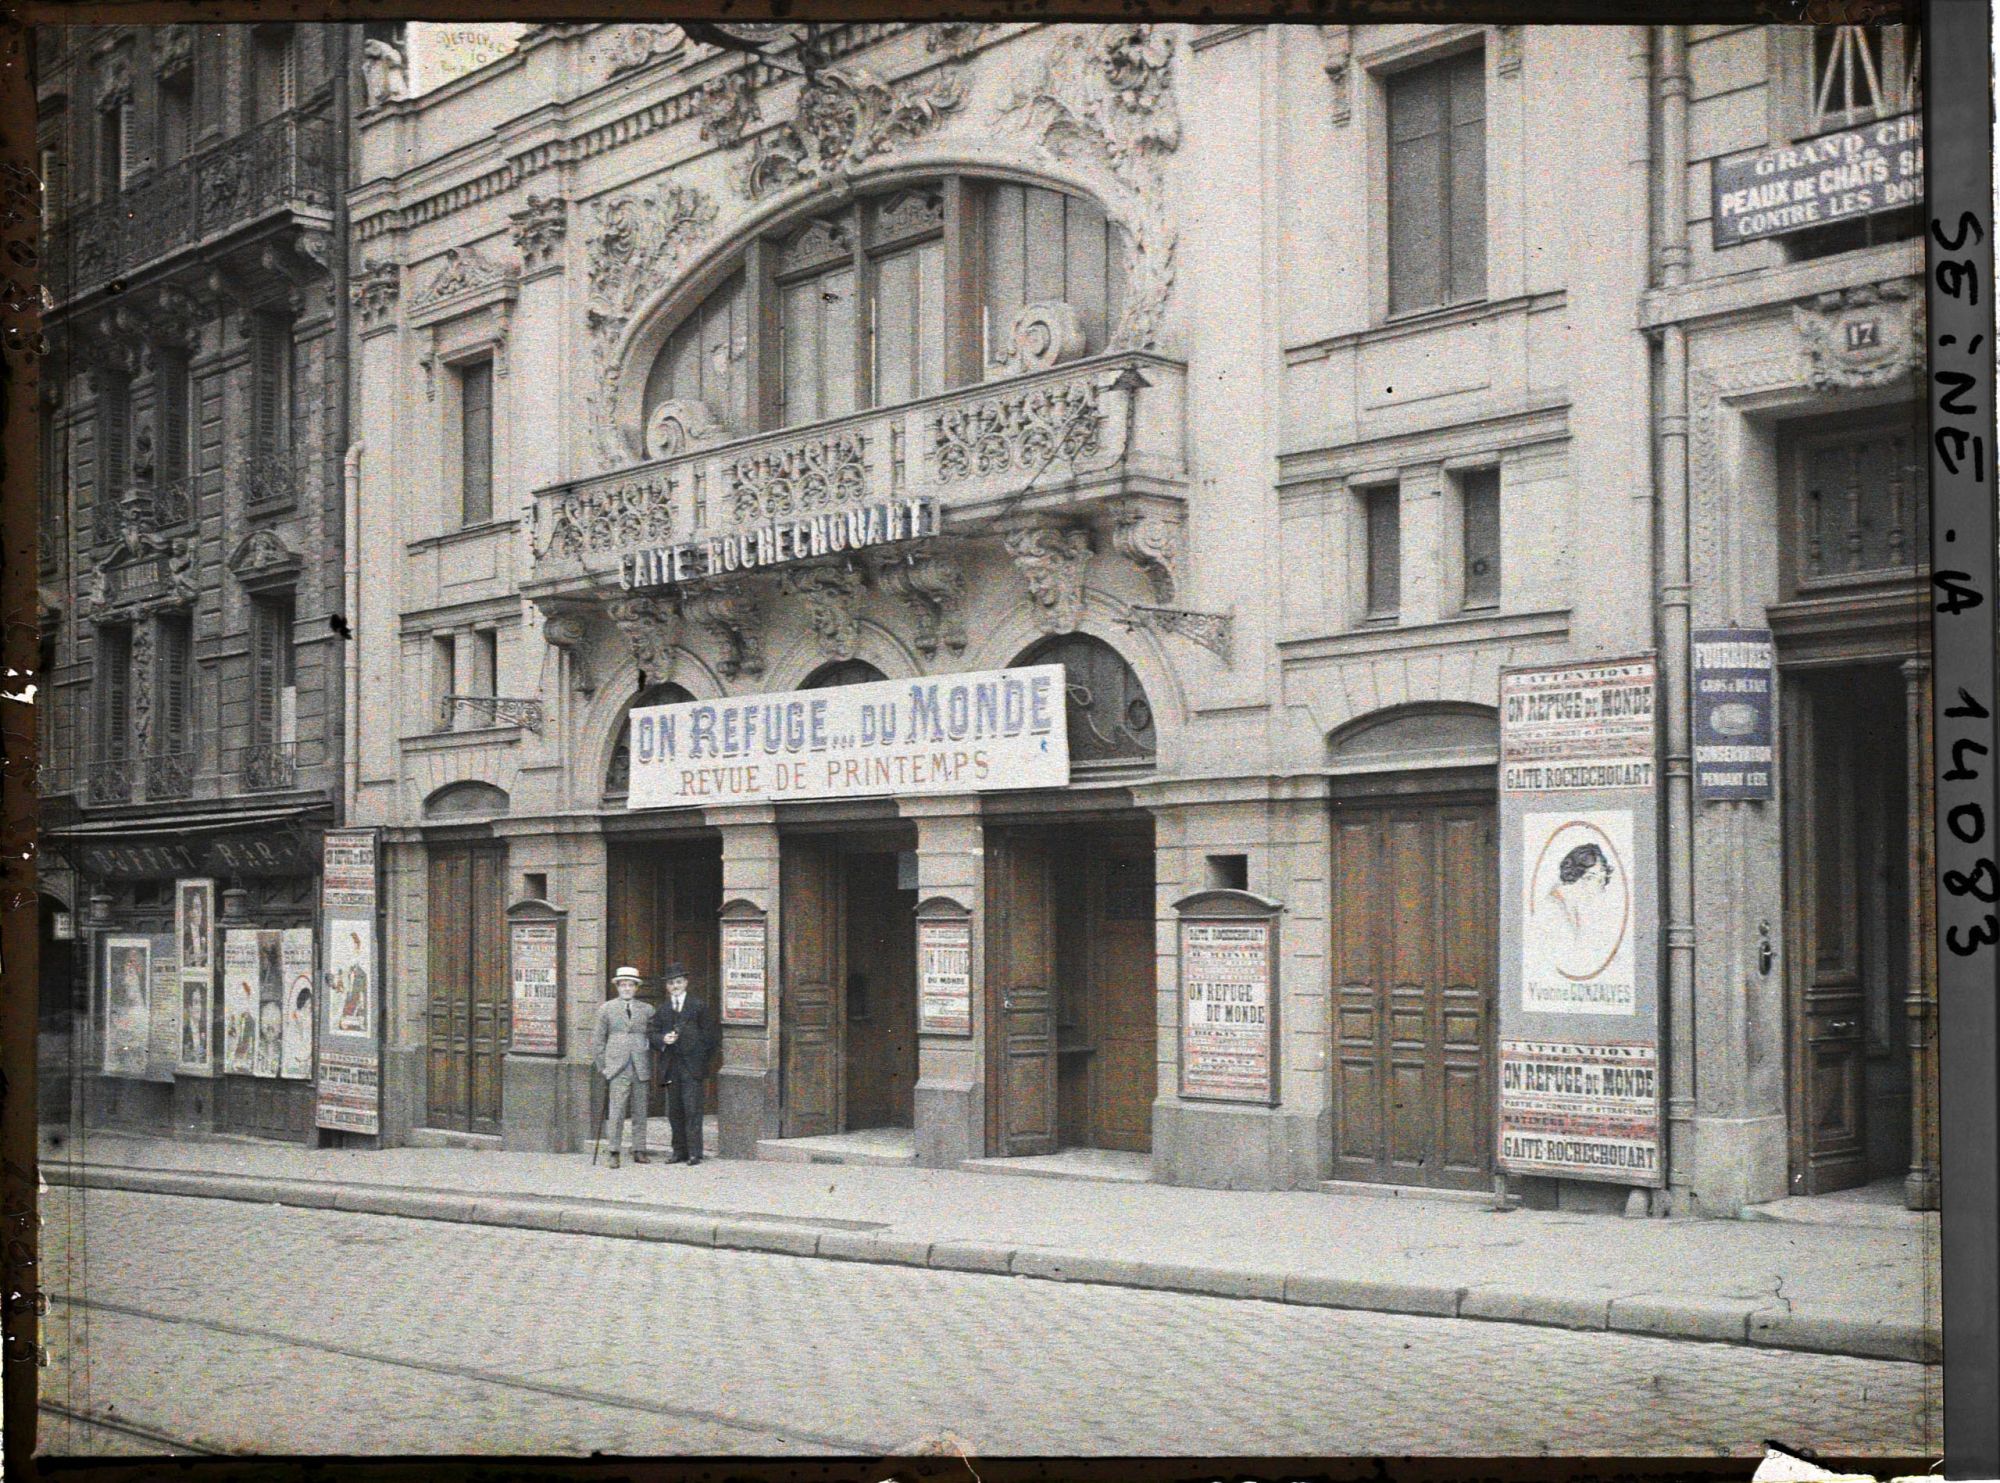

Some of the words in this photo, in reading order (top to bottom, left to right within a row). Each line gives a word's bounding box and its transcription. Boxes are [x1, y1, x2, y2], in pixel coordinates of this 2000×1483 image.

[1755, 133, 1864, 176] GRAND
[1720, 180, 1791, 217] PEAUX
[1793, 176, 1818, 201] DE
[1819, 156, 1889, 194] CHATS
[1737, 200, 1821, 236] CONTRE
[1829, 189, 1873, 216] LES
[1849, 323, 1875, 347] 17
[707, 498, 938, 575] ROCHECHOUART
[1530, 668, 1630, 682] ATTENTION
[637, 713, 677, 765] ON
[861, 702, 898, 744] DU
[909, 674, 1052, 745] MONDE
[1507, 695, 1525, 722] ON
[1601, 686, 1651, 717] MONDE
[679, 764, 760, 797] REVUE
[776, 763, 806, 790] DE
[827, 749, 990, 787] PRINTEMPS
[1546, 763, 1651, 788] ROCHECHOUART
[1940, 688, 2000, 958] 14083
[1189, 982, 1203, 1001] ON
[1206, 983, 1253, 1002] REFUGE
[1206, 1004, 1221, 1023] DU
[1224, 1004, 1265, 1024] MONDE
[1526, 1043, 1632, 1056] ATTENTION
[1504, 1062, 1522, 1089] ON
[1525, 1063, 1583, 1094] REFUGE
[1602, 1067, 1654, 1098] MONDE
[1503, 1137, 1543, 1160] GAITE
[1547, 1139, 1655, 1169] ROCHECHOUART
